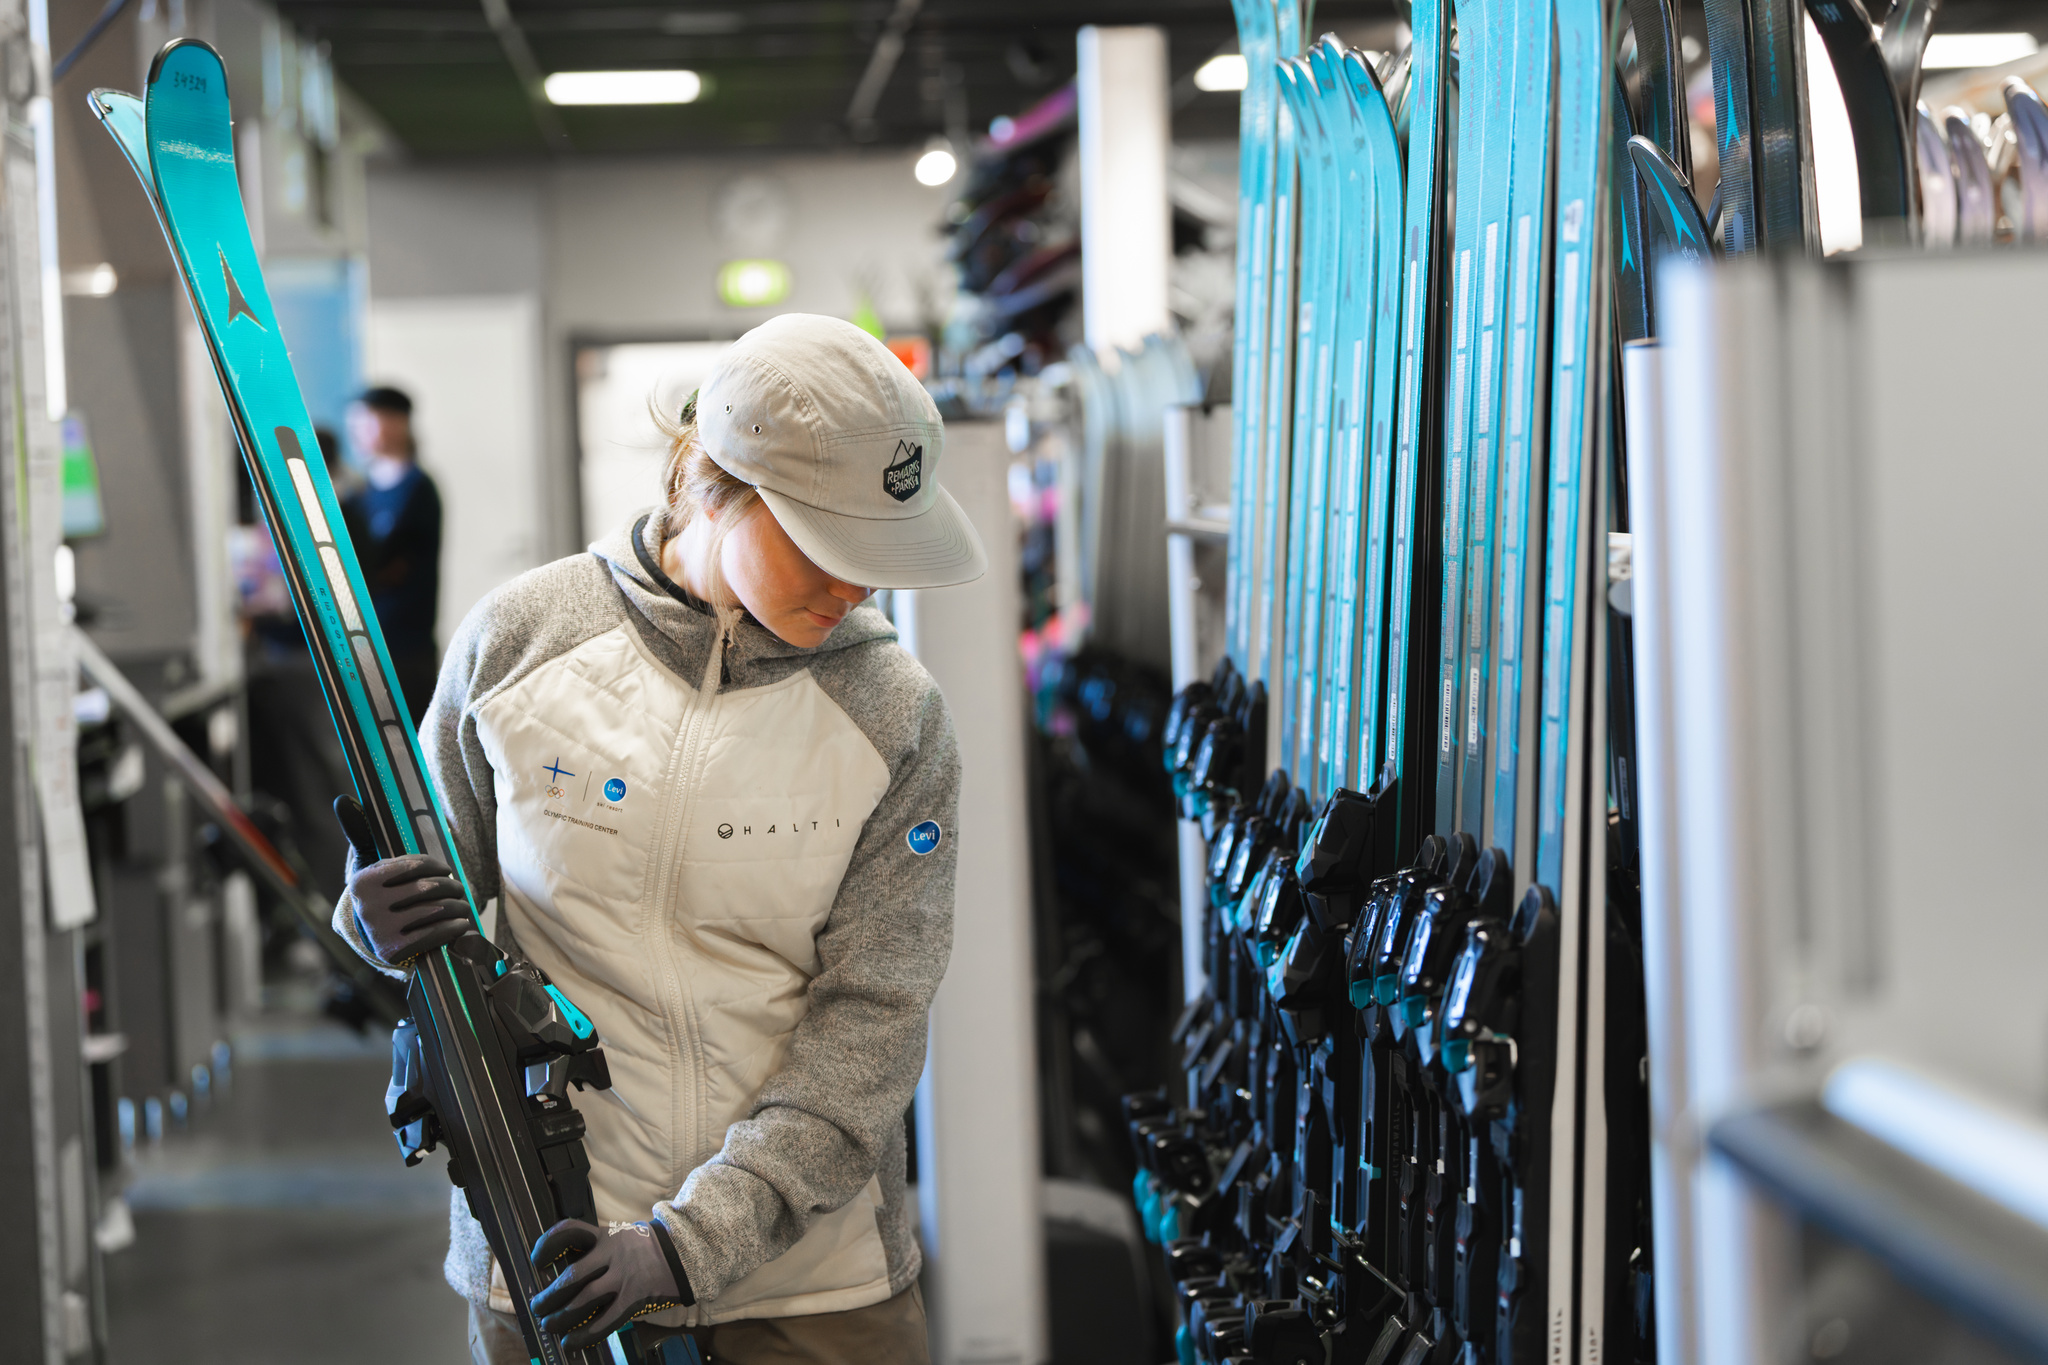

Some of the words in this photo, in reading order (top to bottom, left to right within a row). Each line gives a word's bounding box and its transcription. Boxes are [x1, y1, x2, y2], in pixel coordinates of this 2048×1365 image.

[1766, 0, 1777, 97] OMIC
[887, 459, 920, 485] REMARKS
[319, 587, 357, 682] REDSTER
[607, 784, 624, 795] Levi
[606, 804, 623, 813] resort
[543, 809, 568, 821] OLYMPIC
[567, 816, 594, 829] TRAINING
[594, 824, 619, 836] CENTER
[743, 818, 840, 835] HALTI
[912, 829, 936, 842] Levi
[1392, 1111, 1401, 1178] ULTRAWALL
